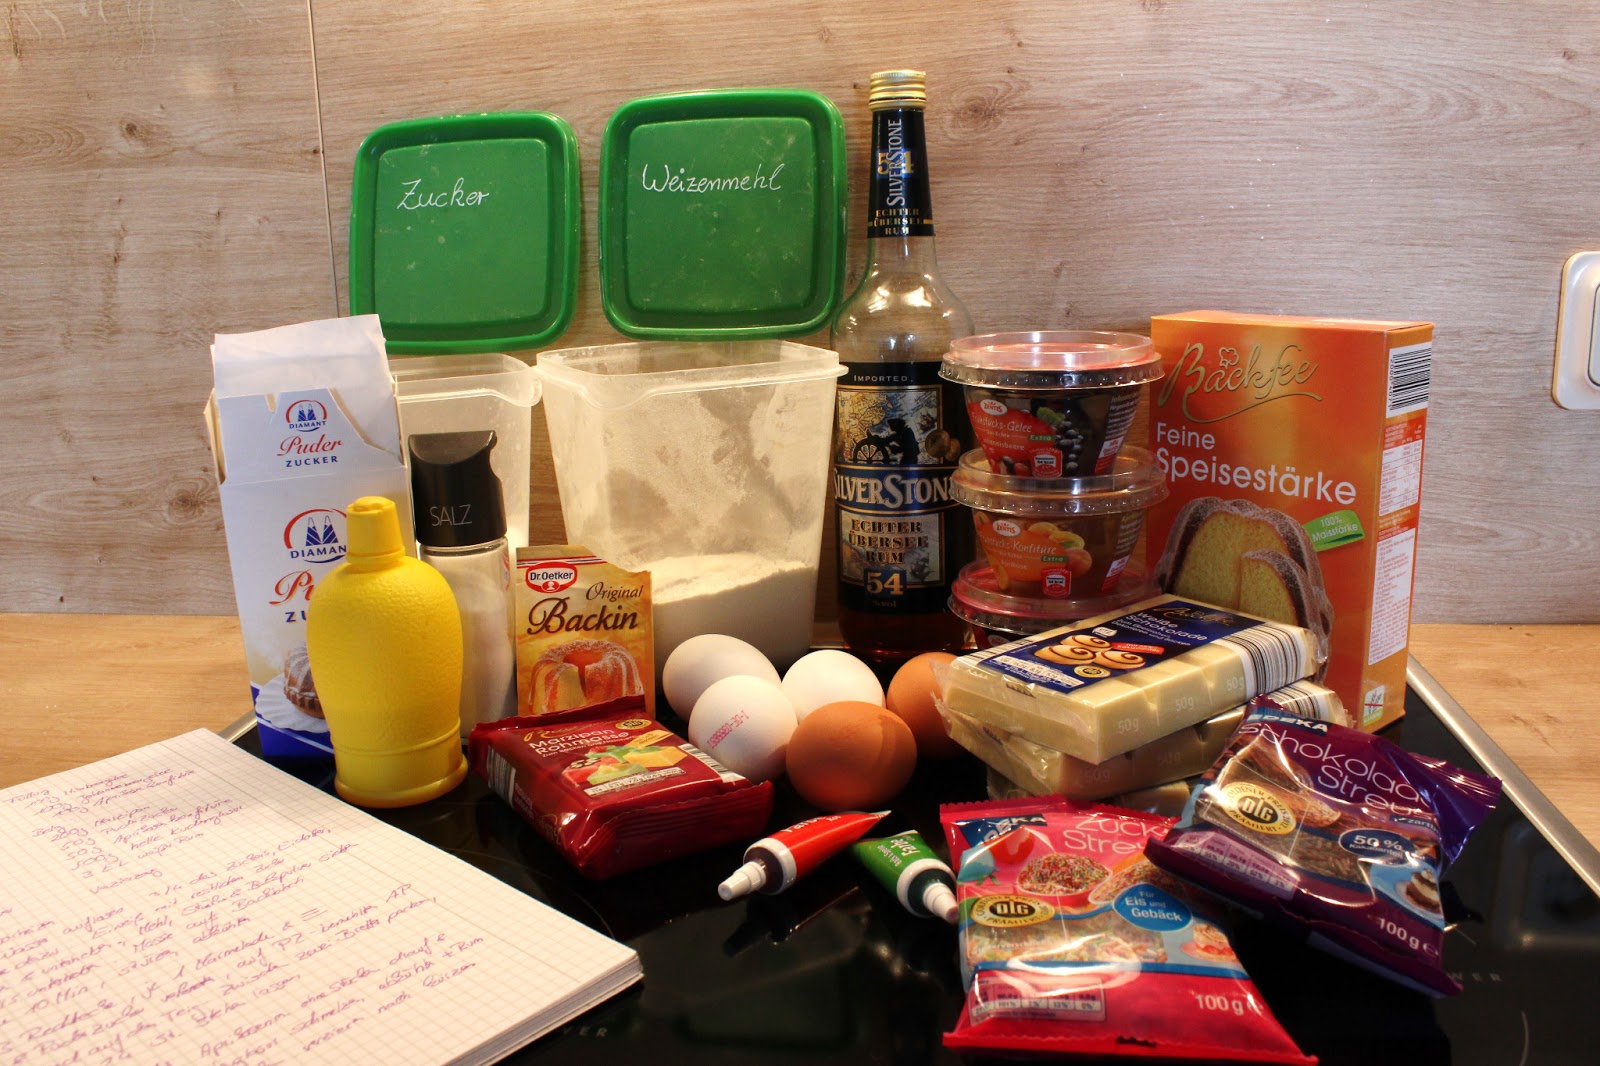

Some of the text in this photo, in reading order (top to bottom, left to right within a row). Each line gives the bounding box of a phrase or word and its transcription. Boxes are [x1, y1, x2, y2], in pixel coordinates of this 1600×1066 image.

[642, 163, 786, 193] Weizenmehl
[397, 177, 490, 210] Zucker
[885, 227, 910, 235] RUM
[289, 421, 326, 429] DIAMANT
[276, 434, 344, 457] Puder
[1157, 422, 1215, 450] Feine
[285, 455, 339, 467] ZUCKER
[1157, 447, 1357, 505] Speisestärke
[834, 467, 952, 509] SILVERSTON
[429, 504, 473, 526] SALZ
[1320, 516, 1343, 527] 100%
[852, 519, 924, 534] ECHTER
[290, 545, 346, 559] DIAMAN
[866, 550, 906, 564] RUM
[586, 581, 644, 602] Original
[867, 572, 904, 596] 54
[526, 597, 638, 635] Backin
[1125, 614, 1208, 641] Schokolade
[1175, 696, 1195, 712] 50g
[1117, 718, 1140, 735] 50g
[529, 729, 615, 749] Marzipan
[535, 731, 630, 755] Rohmasse
[1075, 816, 1164, 837] Zuck
[1124, 897, 1147, 906] Eis
[1131, 908, 1183, 922] Gebäck
[1377, 918, 1407, 941] 100
[1195, 992, 1229, 1011] 100
